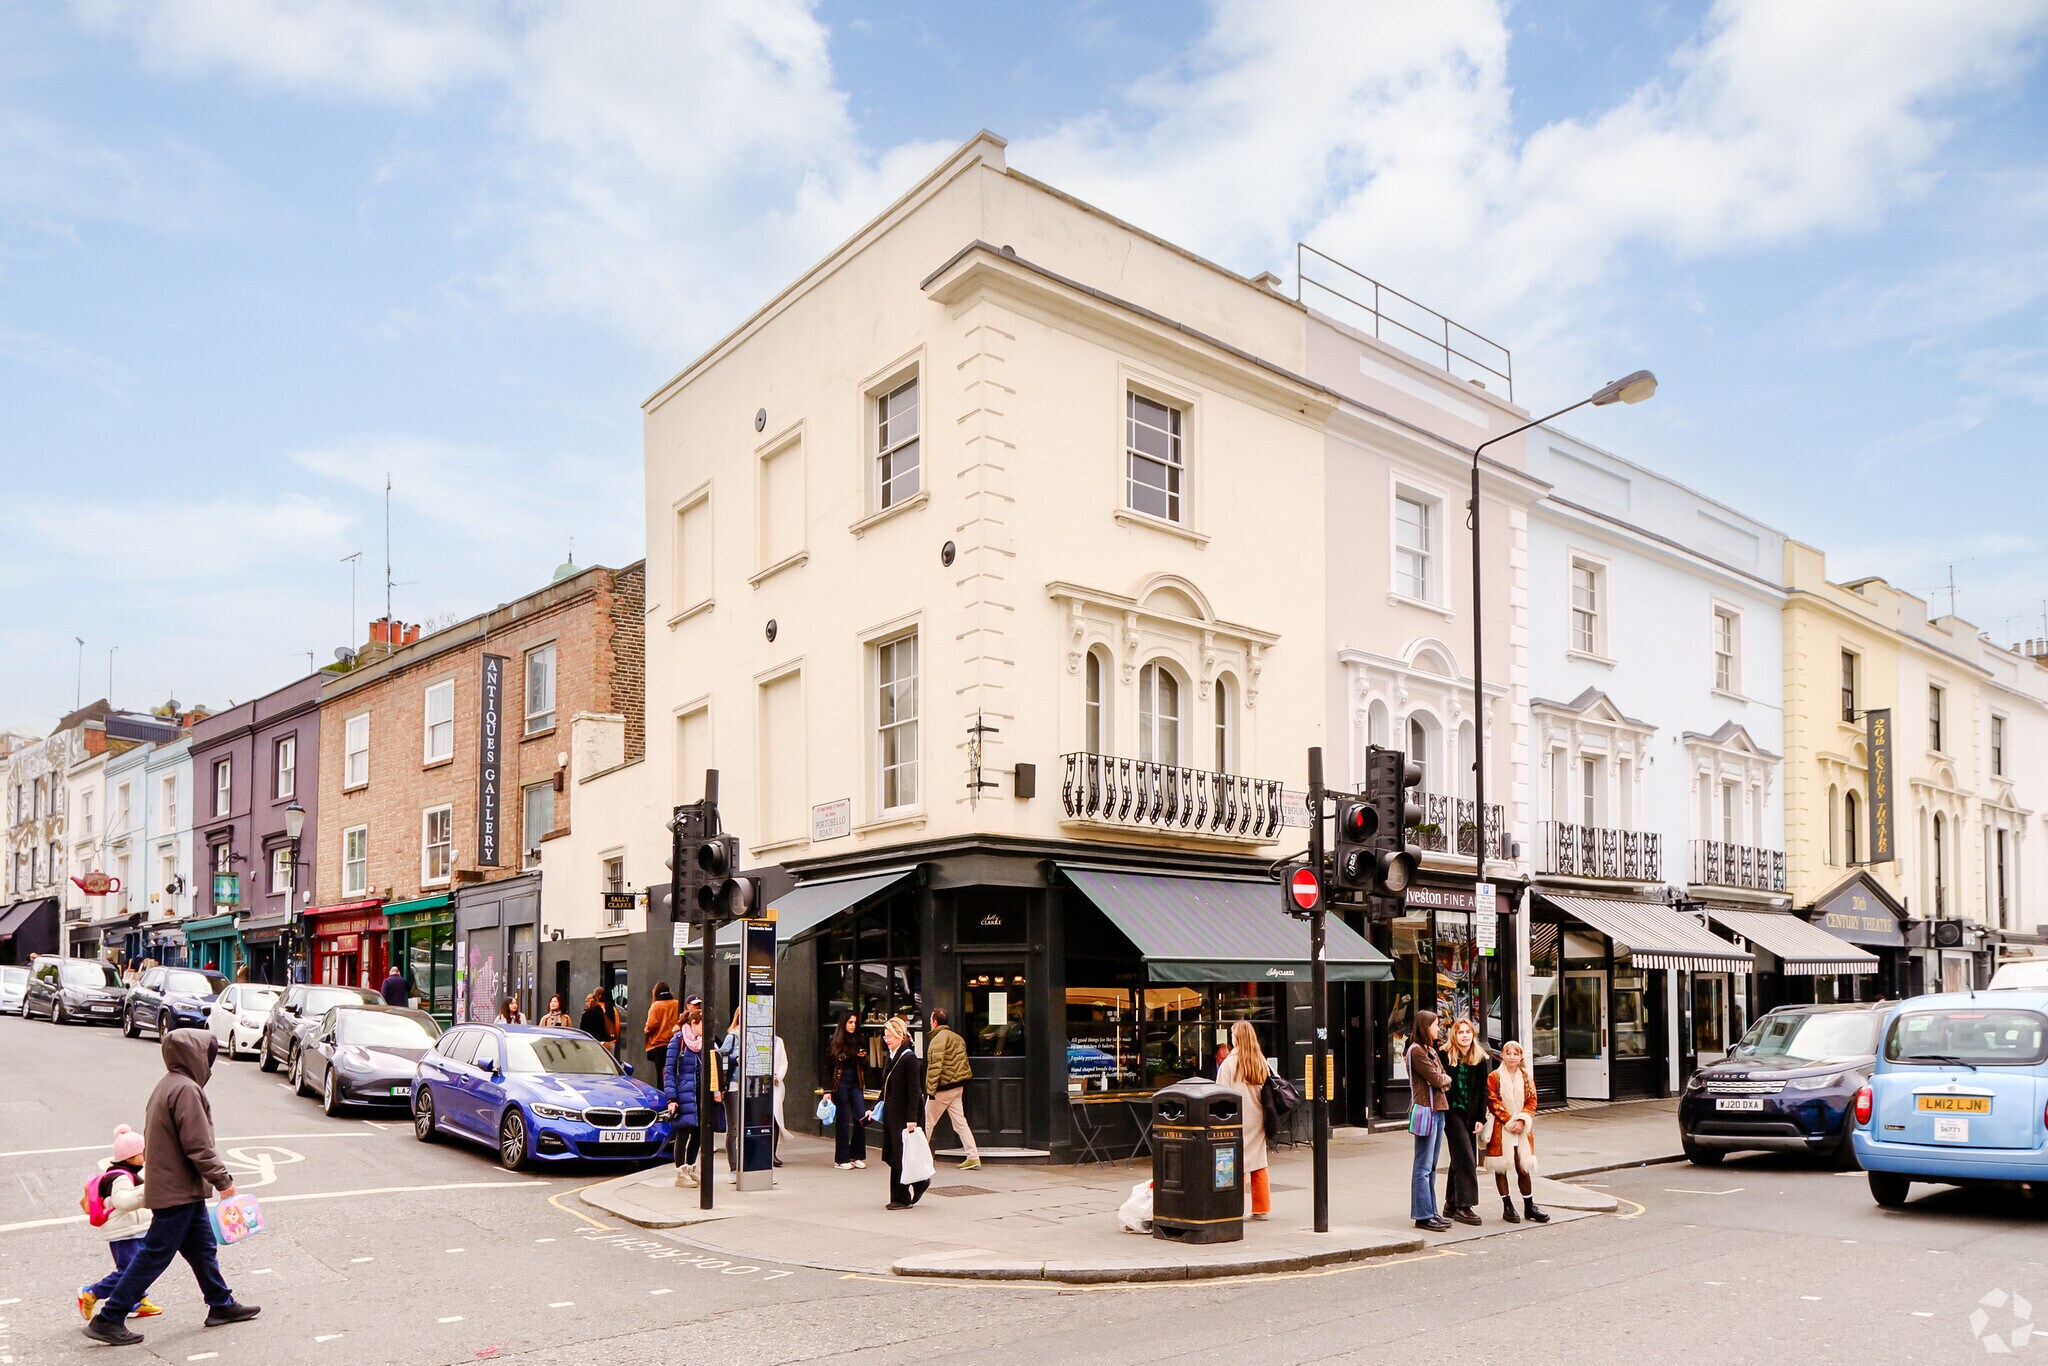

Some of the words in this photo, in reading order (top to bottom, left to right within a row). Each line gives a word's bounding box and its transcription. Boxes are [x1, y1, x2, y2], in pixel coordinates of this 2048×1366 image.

[485, 659, 498, 763] ANTIQUES
[1874, 718, 1886, 746] 20th
[1875, 749, 1887, 800] CENTURY
[484, 769, 496, 861] GALLERY
[816, 816, 846, 829] PORTOBELLO
[819, 827, 832, 838] ROAD
[1876, 802, 1888, 853] THEATRE
[1406, 887, 1442, 904] lveston
[1444, 893, 1465, 906] FINE
[1852, 896, 1867, 911] 20th
[1826, 913, 1860, 930] CENTURY
[1863, 916, 1893, 933] THEATRE
[396, 1086, 411, 1095] LA2
[1720, 1100, 1741, 1109] WJ20
[1742, 1100, 1759, 1109] DXA
[1926, 1099, 1953, 1110] LM12
[1957, 1099, 1982, 1111] LJN
[604, 1132, 624, 1141] LV71
[625, 1132, 641, 1141] FOD
